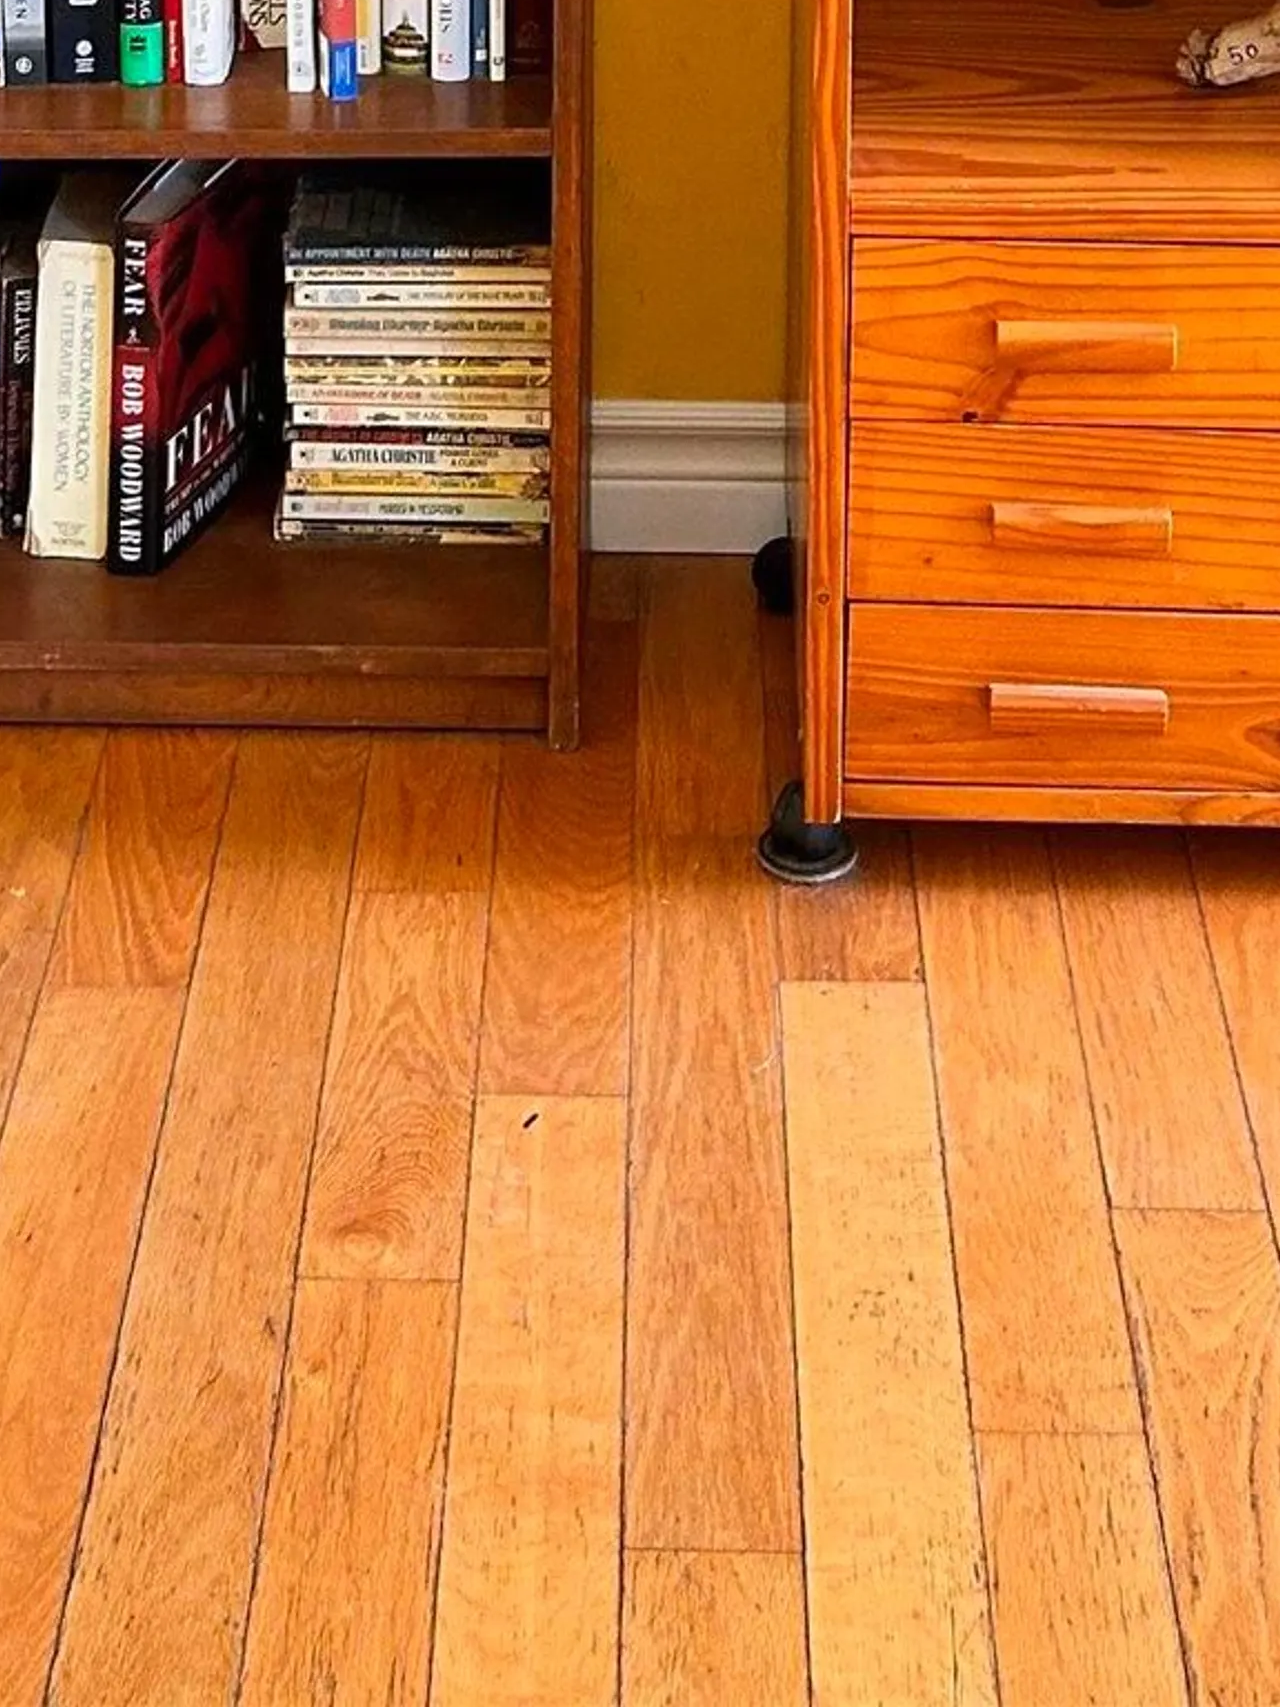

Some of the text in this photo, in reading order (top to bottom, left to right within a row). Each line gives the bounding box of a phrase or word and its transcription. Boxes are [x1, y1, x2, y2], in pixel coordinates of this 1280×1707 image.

[118, 238, 146, 562] FEAR BOB WOODWARD
